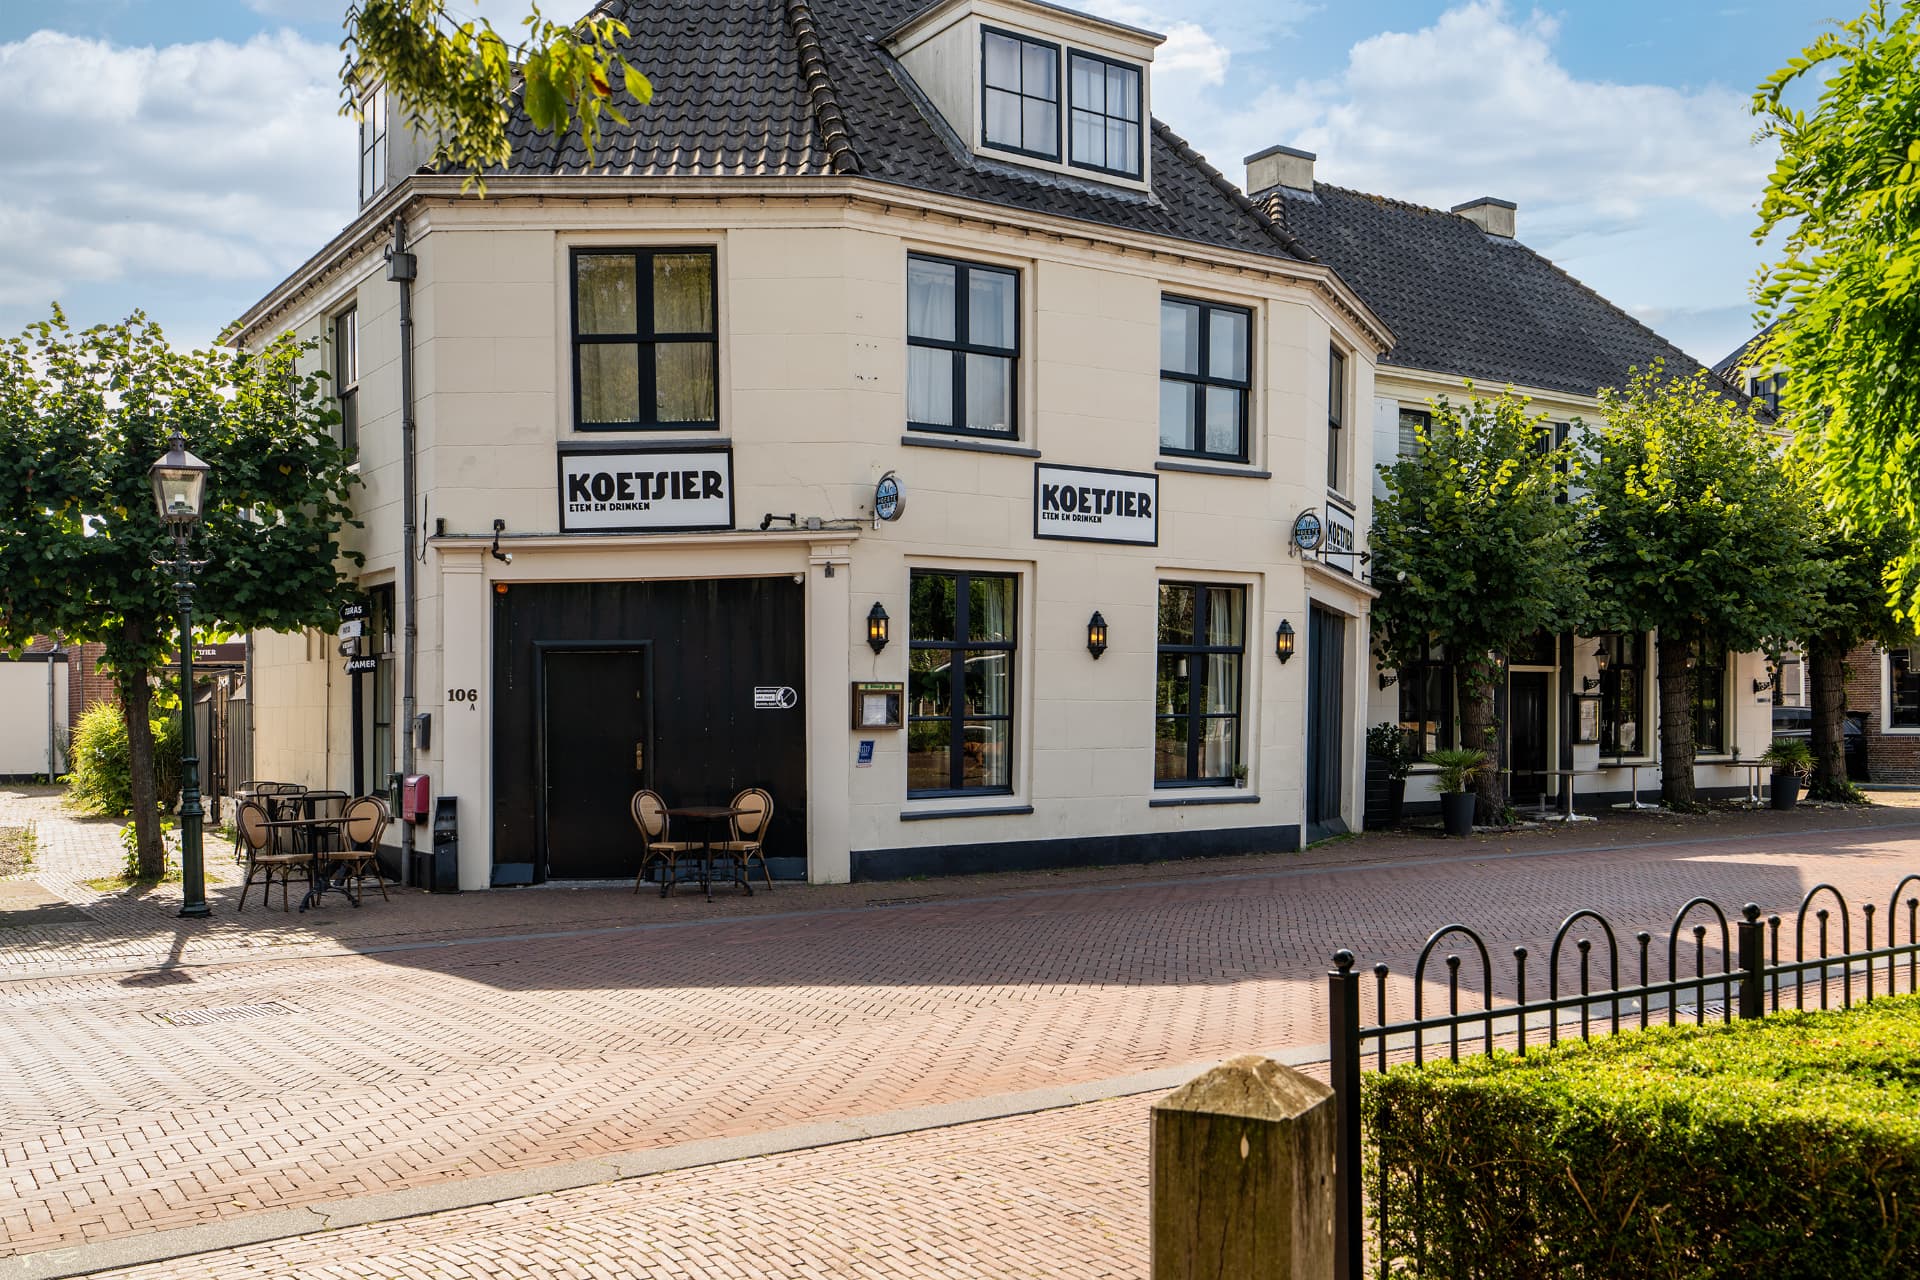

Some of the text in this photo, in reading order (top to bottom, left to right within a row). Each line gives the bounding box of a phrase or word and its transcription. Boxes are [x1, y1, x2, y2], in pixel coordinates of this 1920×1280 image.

[568, 470, 724, 502] KOETSIER
[569, 502, 650, 512] ETEN EN DRINKEN
[1042, 484, 1152, 519] KOETSIER
[1042, 512, 1102, 523] ETEN EN DRINKEN
[349, 659, 376, 669] KAMER
[447, 688, 478, 702] 106
